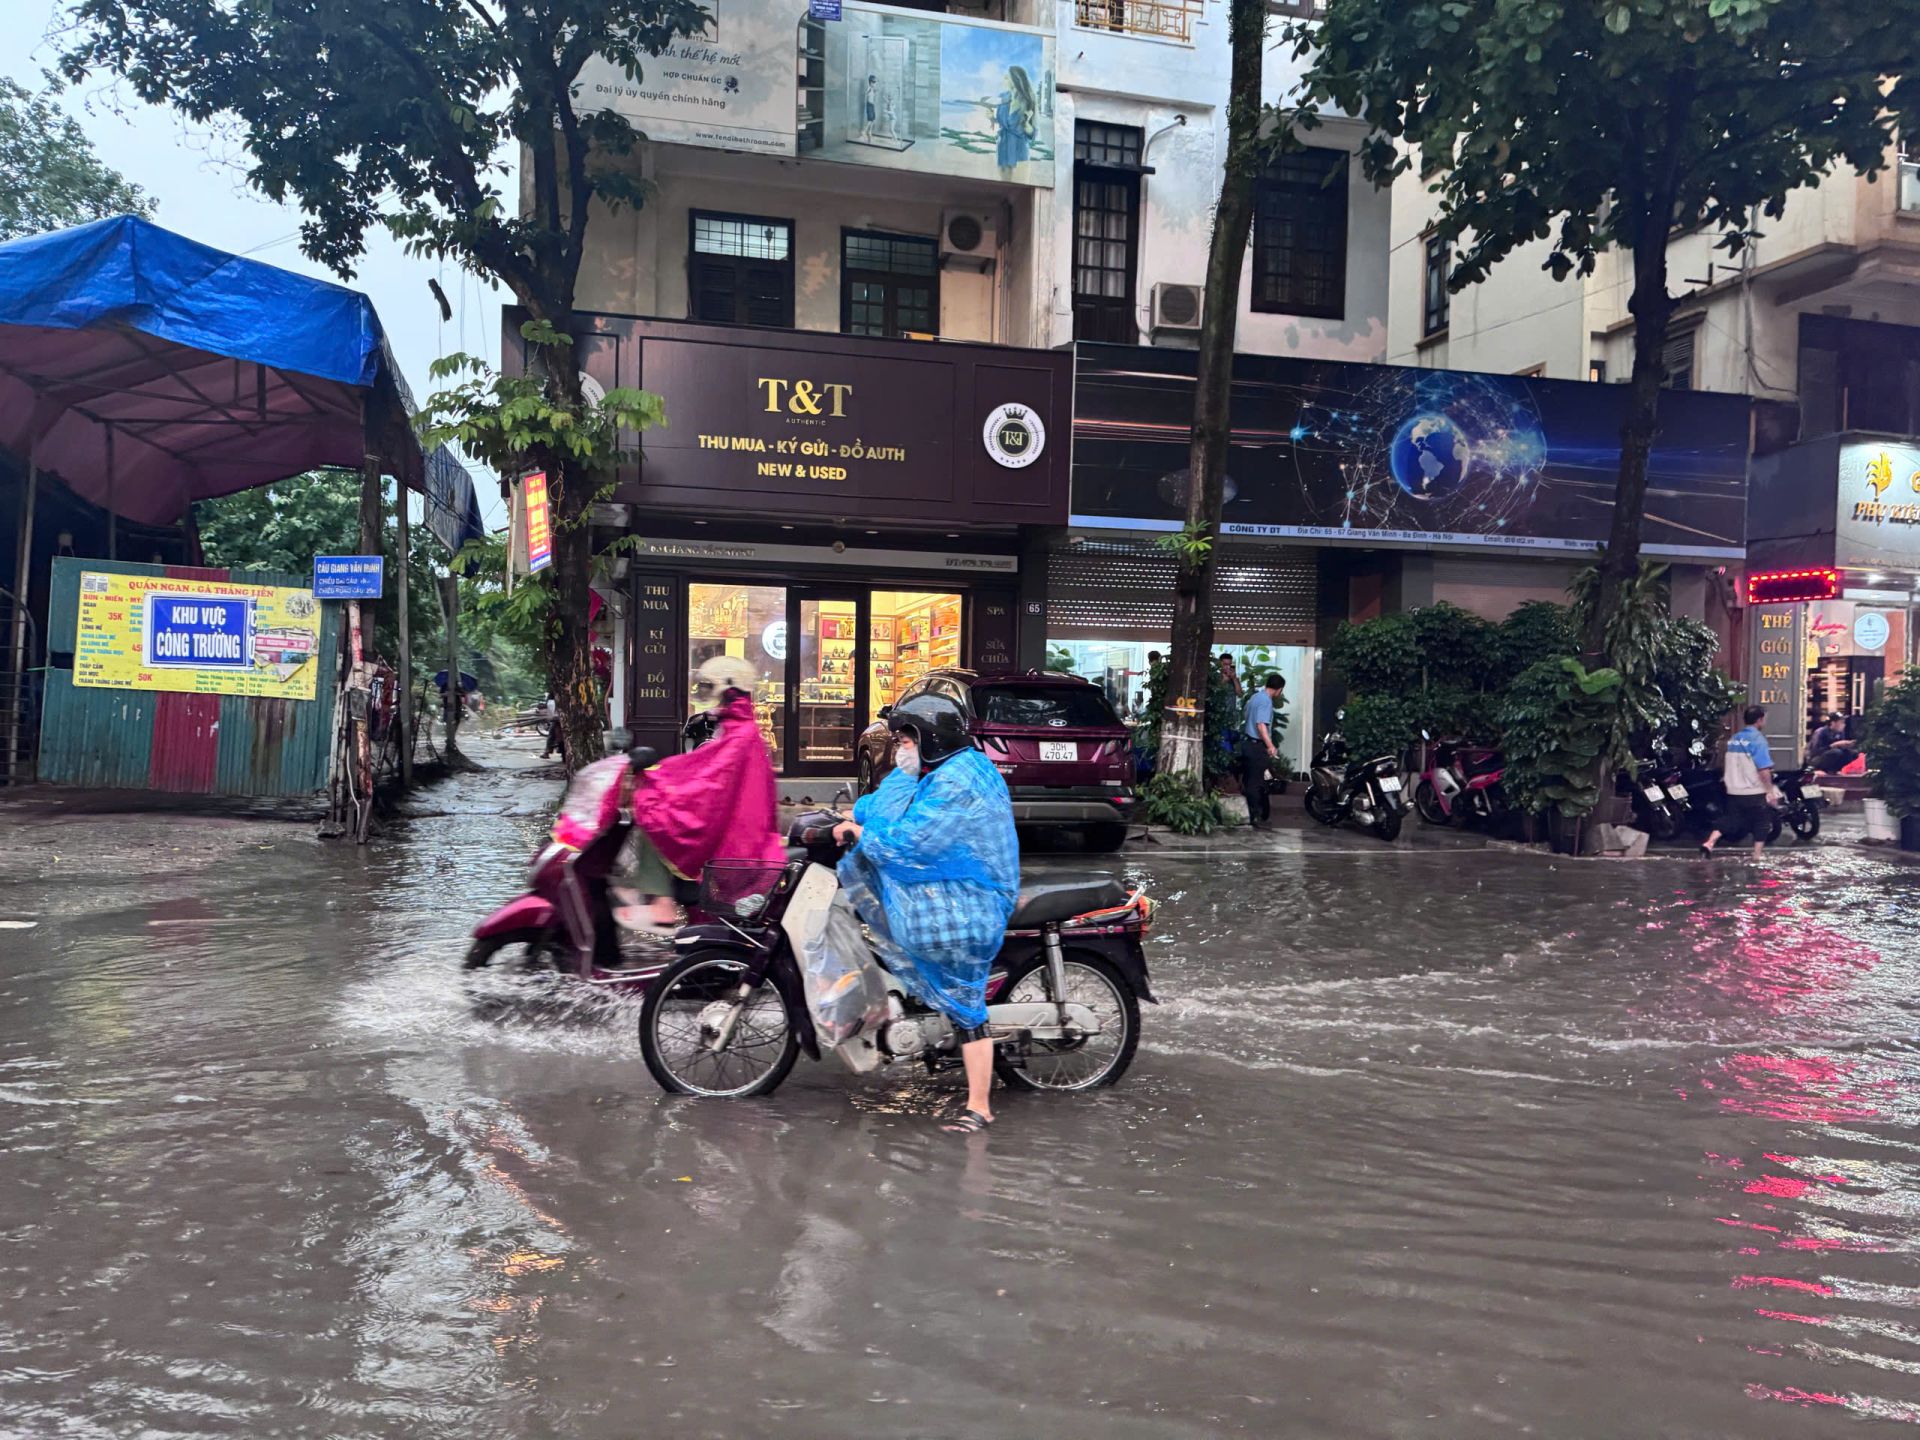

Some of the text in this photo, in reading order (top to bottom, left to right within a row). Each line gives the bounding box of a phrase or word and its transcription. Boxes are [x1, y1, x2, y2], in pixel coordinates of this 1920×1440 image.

[595, 84, 612, 94] Đại
[614, 86, 624, 97] lý
[672, 93, 700, 105] chính
[758, 377, 853, 417] T&T
[1001, 430, 1027, 446] T&T
[698, 434, 729, 450] THU
[731, 437, 766, 453] MUA
[776, 436, 799, 454] KÝ
[800, 438, 829, 457] GỬI
[839, 438, 865, 459] ĐỒ
[865, 446, 905, 462] AUTH
[757, 462, 848, 481] NEW & USED
[1229, 523, 1255, 533] CÔNG
[1257, 525, 1267, 534] TY
[128, 580, 159, 591] QUÁN
[160, 583, 190, 593] NGAN
[644, 585, 670, 596] THU
[643, 600, 670, 610] MUA
[986, 606, 1005, 616] SPA
[1028, 603, 1041, 613] 65
[107, 612, 123, 621] 35K
[172, 606, 198, 625] KHU
[201, 605, 227, 629] VỰC
[1761, 609, 1793, 629] THẾ
[649, 627, 664, 640] KÍ
[156, 627, 190, 658] CÔNG
[193, 627, 241, 660] TRƯỜNG
[644, 642, 667, 655] GỬI
[1760, 637, 1792, 654] GIỚI
[138, 673, 153, 681] 50K
[1762, 662, 1790, 683] BẬT
[640, 686, 671, 699] HIỆU
[1760, 683, 1789, 704] LỬA
[1050, 742, 1067, 751] 30H
[1044, 751, 1074, 760] 470.47
